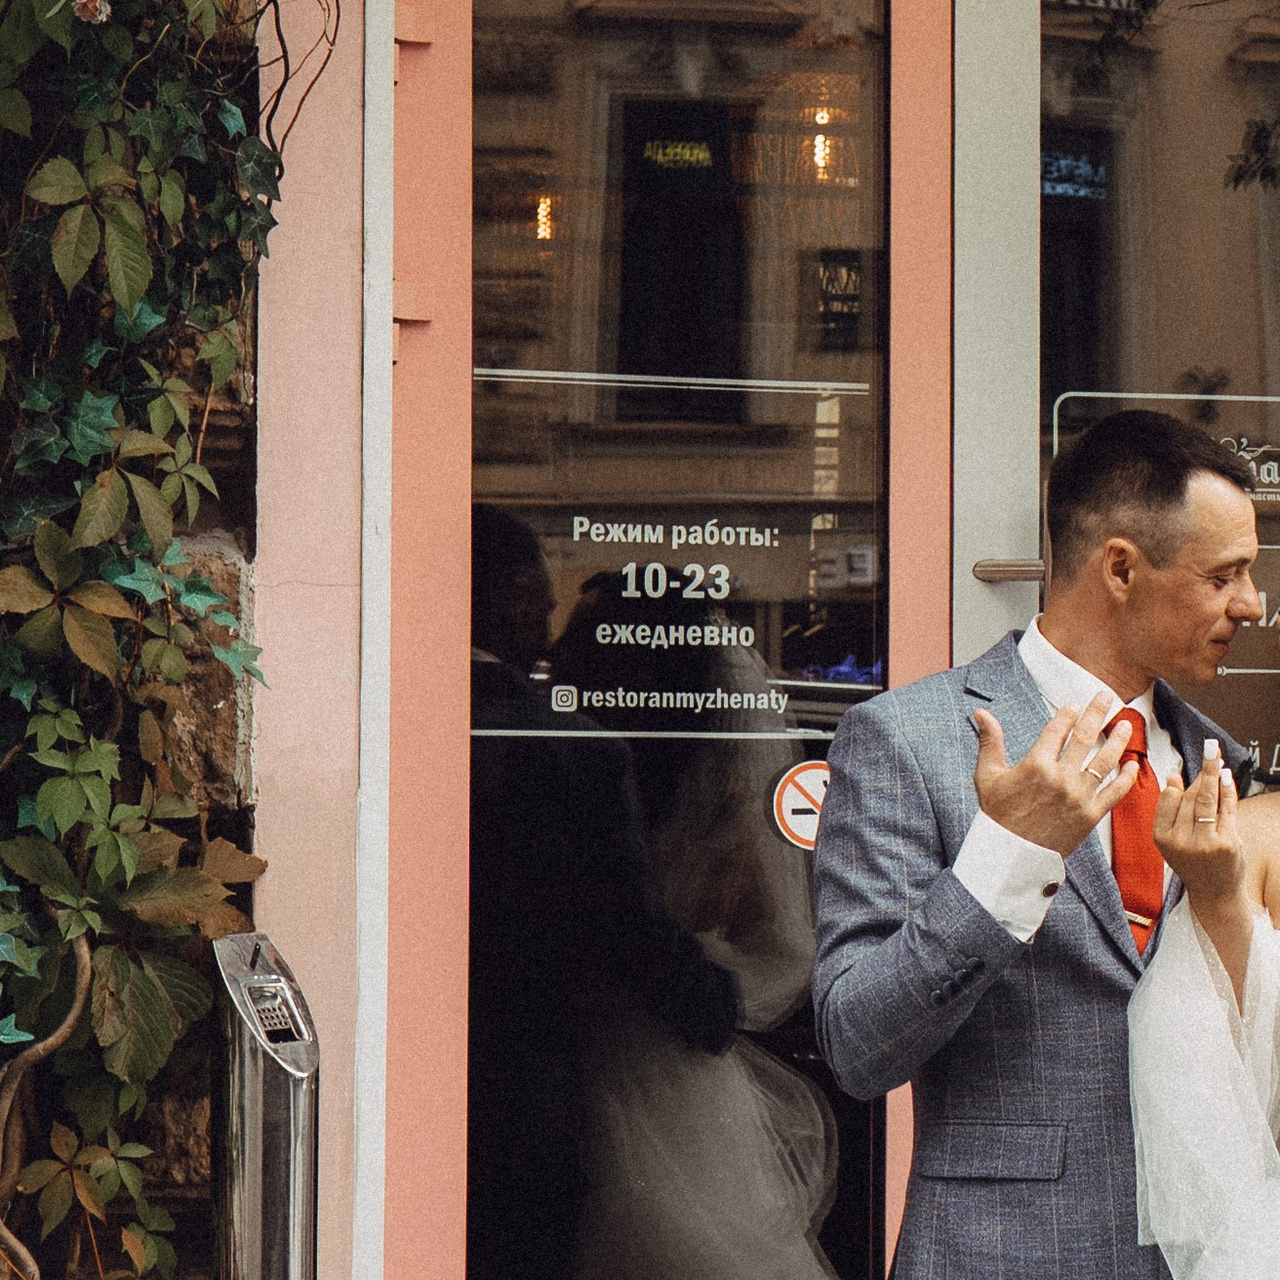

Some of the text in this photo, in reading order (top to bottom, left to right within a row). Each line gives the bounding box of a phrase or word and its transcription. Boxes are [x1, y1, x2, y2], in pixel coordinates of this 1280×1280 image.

[573, 516, 780, 549] Режим работы:
[621, 561, 731, 600] 10-23
[595, 622, 755, 649] ежедневно
[582, 685, 789, 714] restoranmyzhenaty
